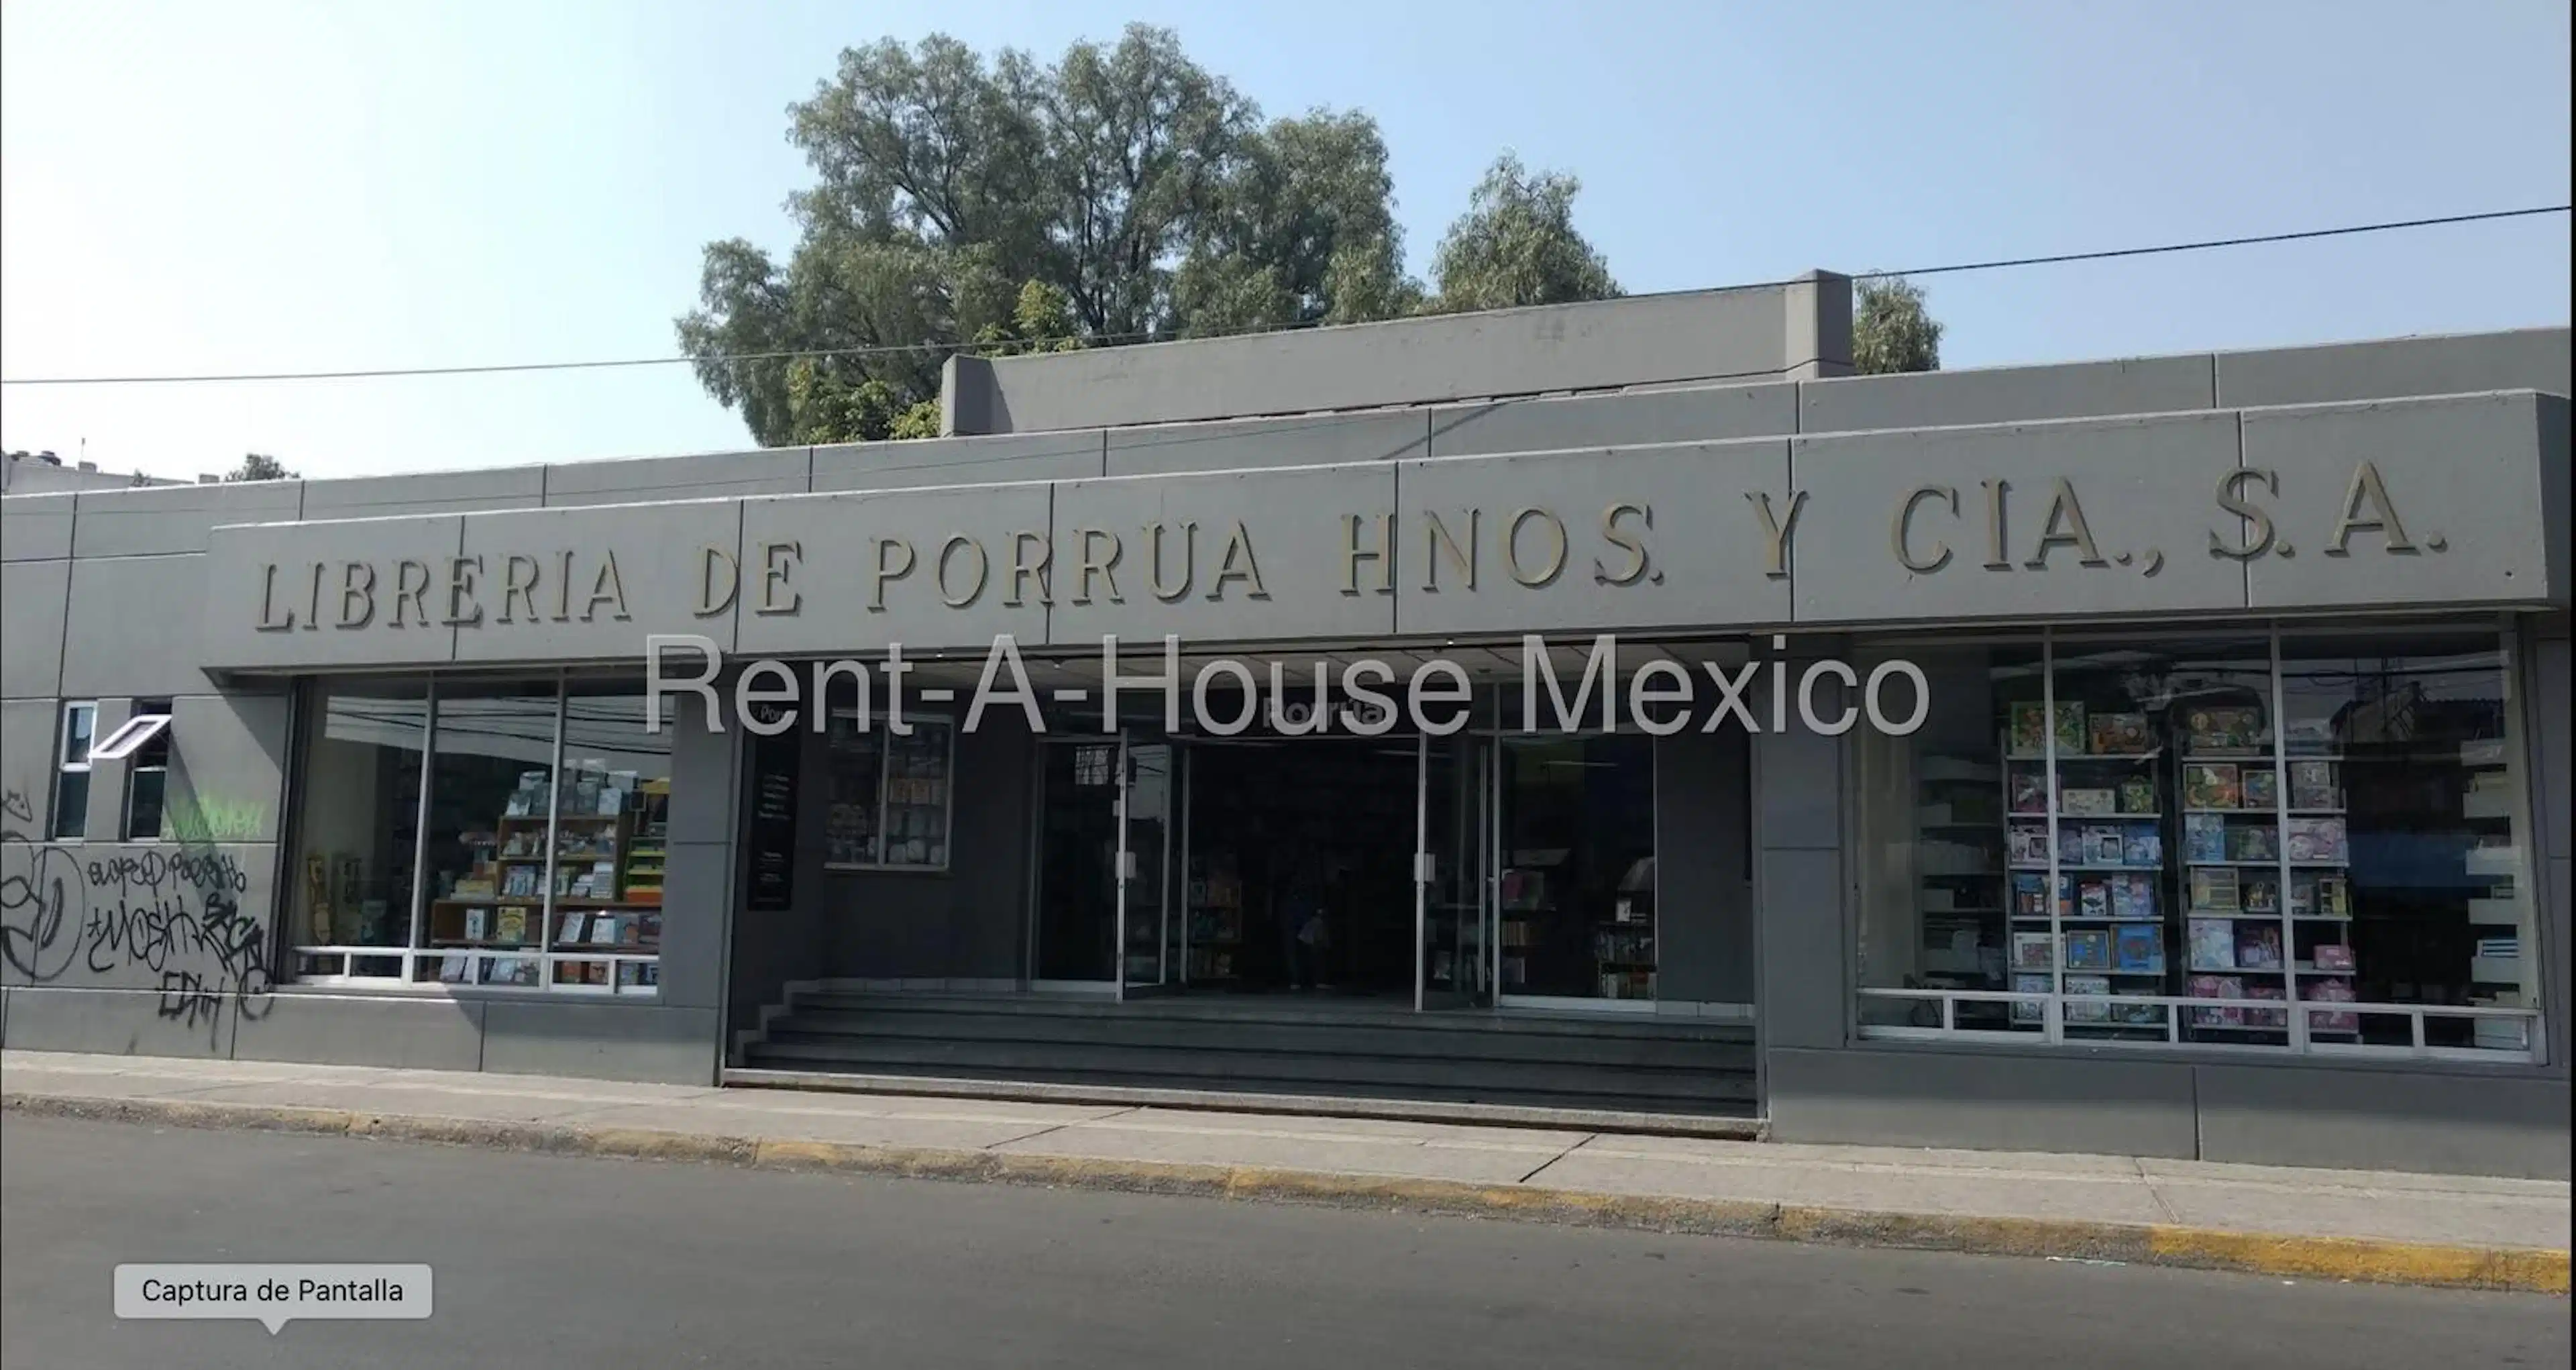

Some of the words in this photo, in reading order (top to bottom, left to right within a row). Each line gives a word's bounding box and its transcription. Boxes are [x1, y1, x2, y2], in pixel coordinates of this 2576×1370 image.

[255, 548, 633, 633] LIBRERIA
[692, 539, 804, 619] DE
[867, 518, 1273, 614] PORRUA
[1340, 502, 1665, 597] HNOS.
[1743, 489, 1810, 582] Y
